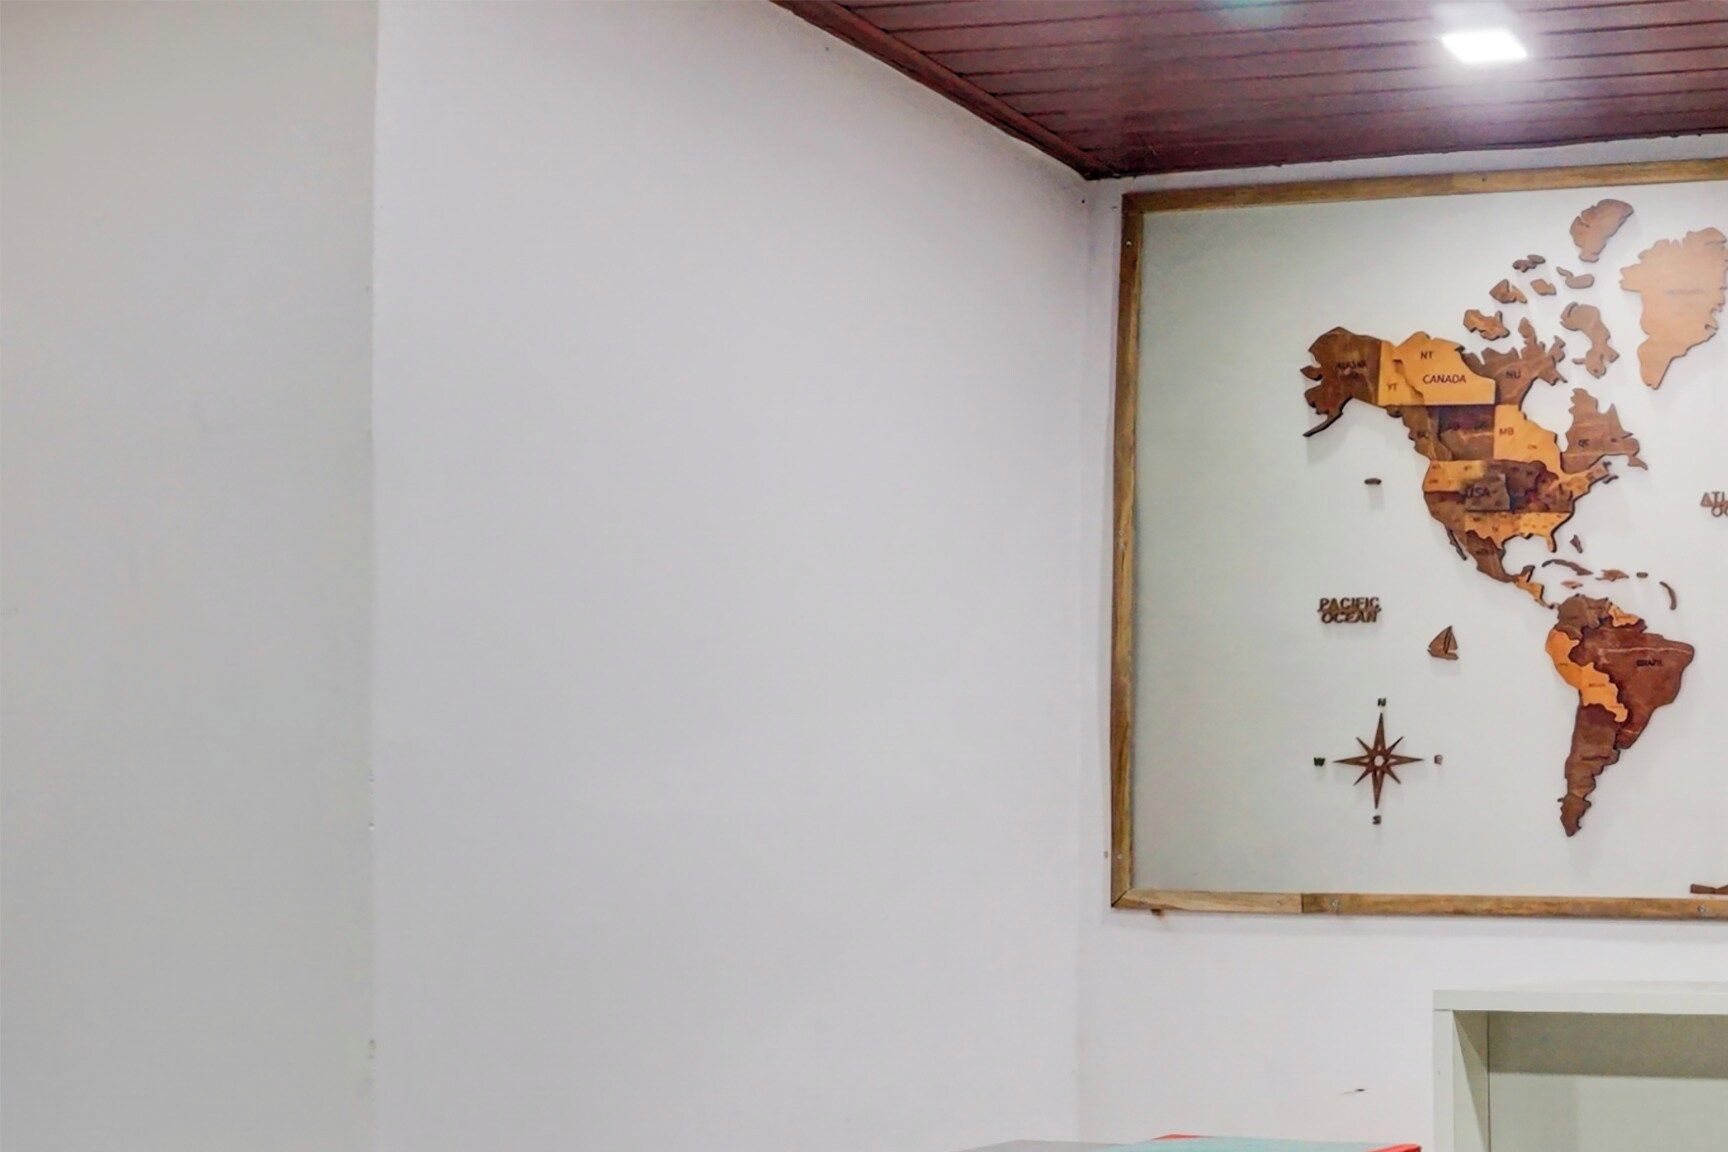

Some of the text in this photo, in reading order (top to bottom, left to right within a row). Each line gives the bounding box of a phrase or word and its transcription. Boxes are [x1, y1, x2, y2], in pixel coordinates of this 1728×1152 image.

[1420, 351, 1434, 360] NT
[1422, 373, 1467, 384] CANADA
[1319, 597, 1380, 611] PACIFIC
[1321, 609, 1377, 623] OCEAN
